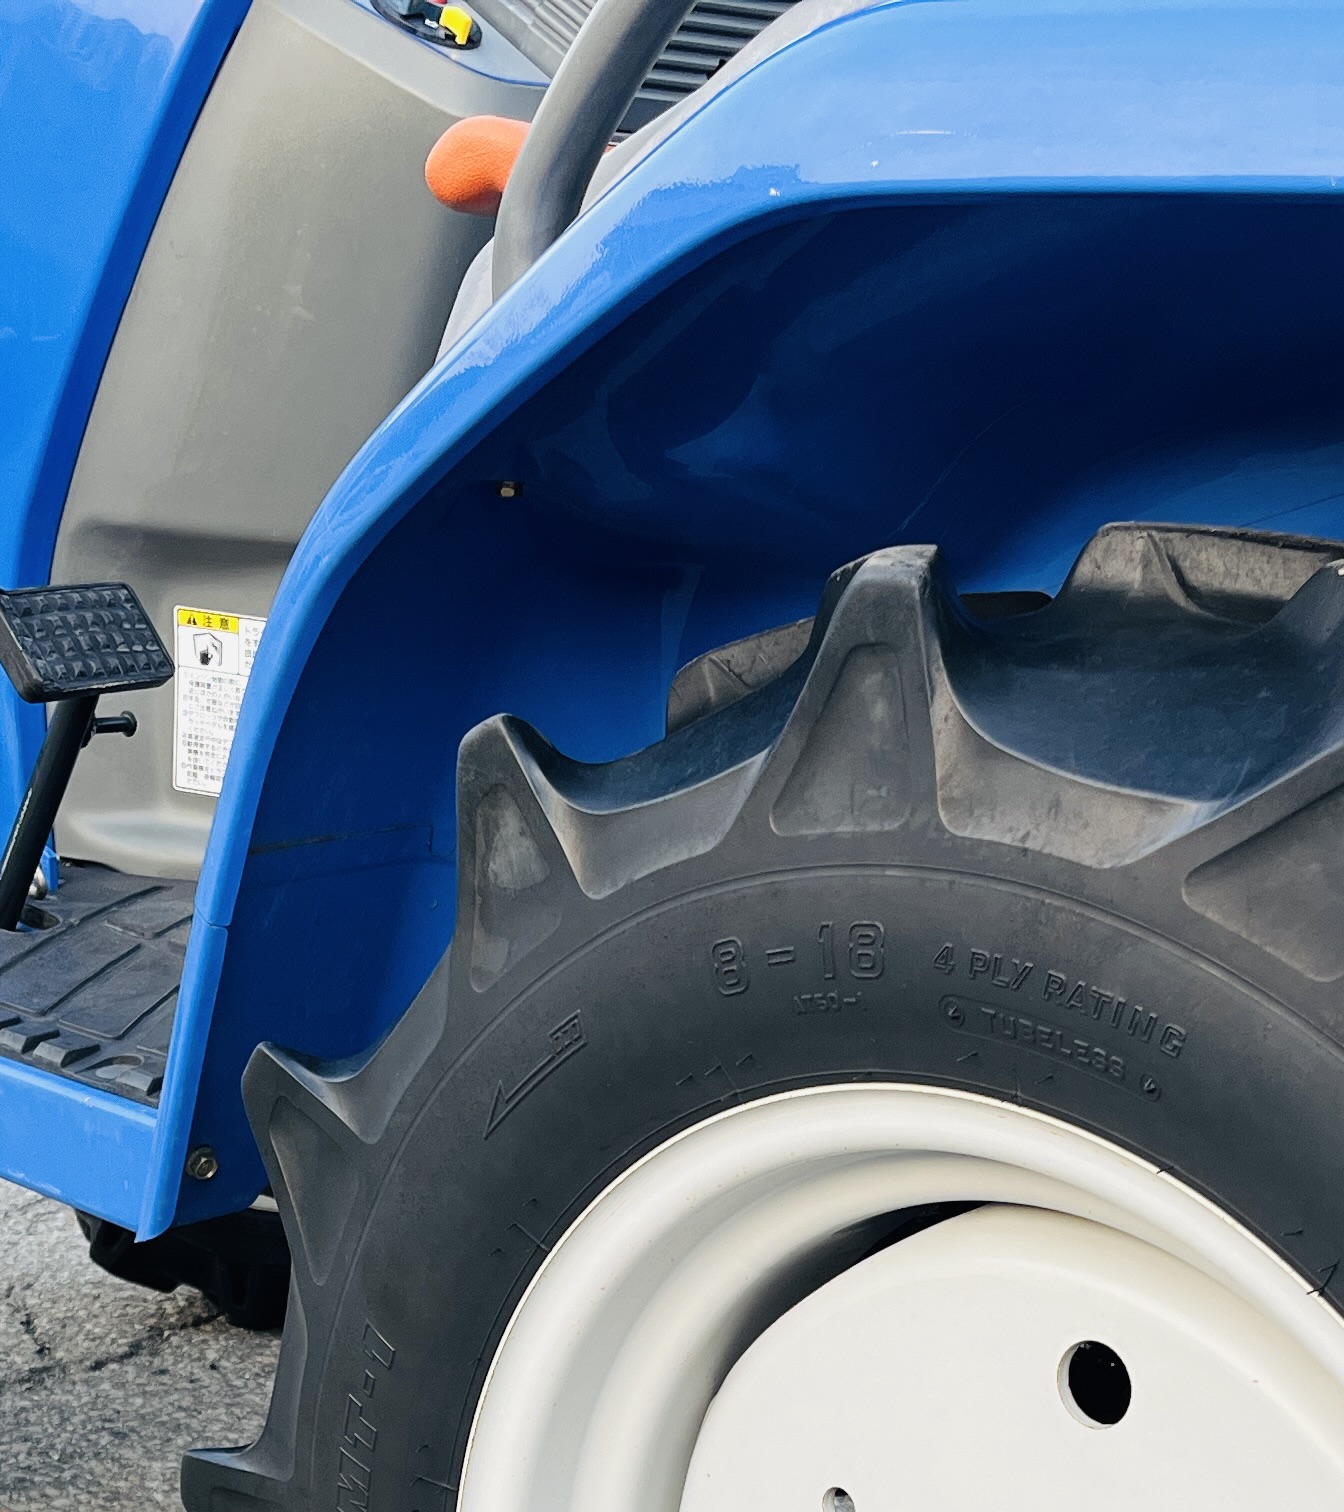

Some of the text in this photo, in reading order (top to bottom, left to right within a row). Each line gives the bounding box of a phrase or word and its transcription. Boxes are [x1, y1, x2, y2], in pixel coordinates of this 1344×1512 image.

[932, 942, 1189, 1059] 4 PLY RATING
[980, 1006, 1127, 1082] TUBELESS
